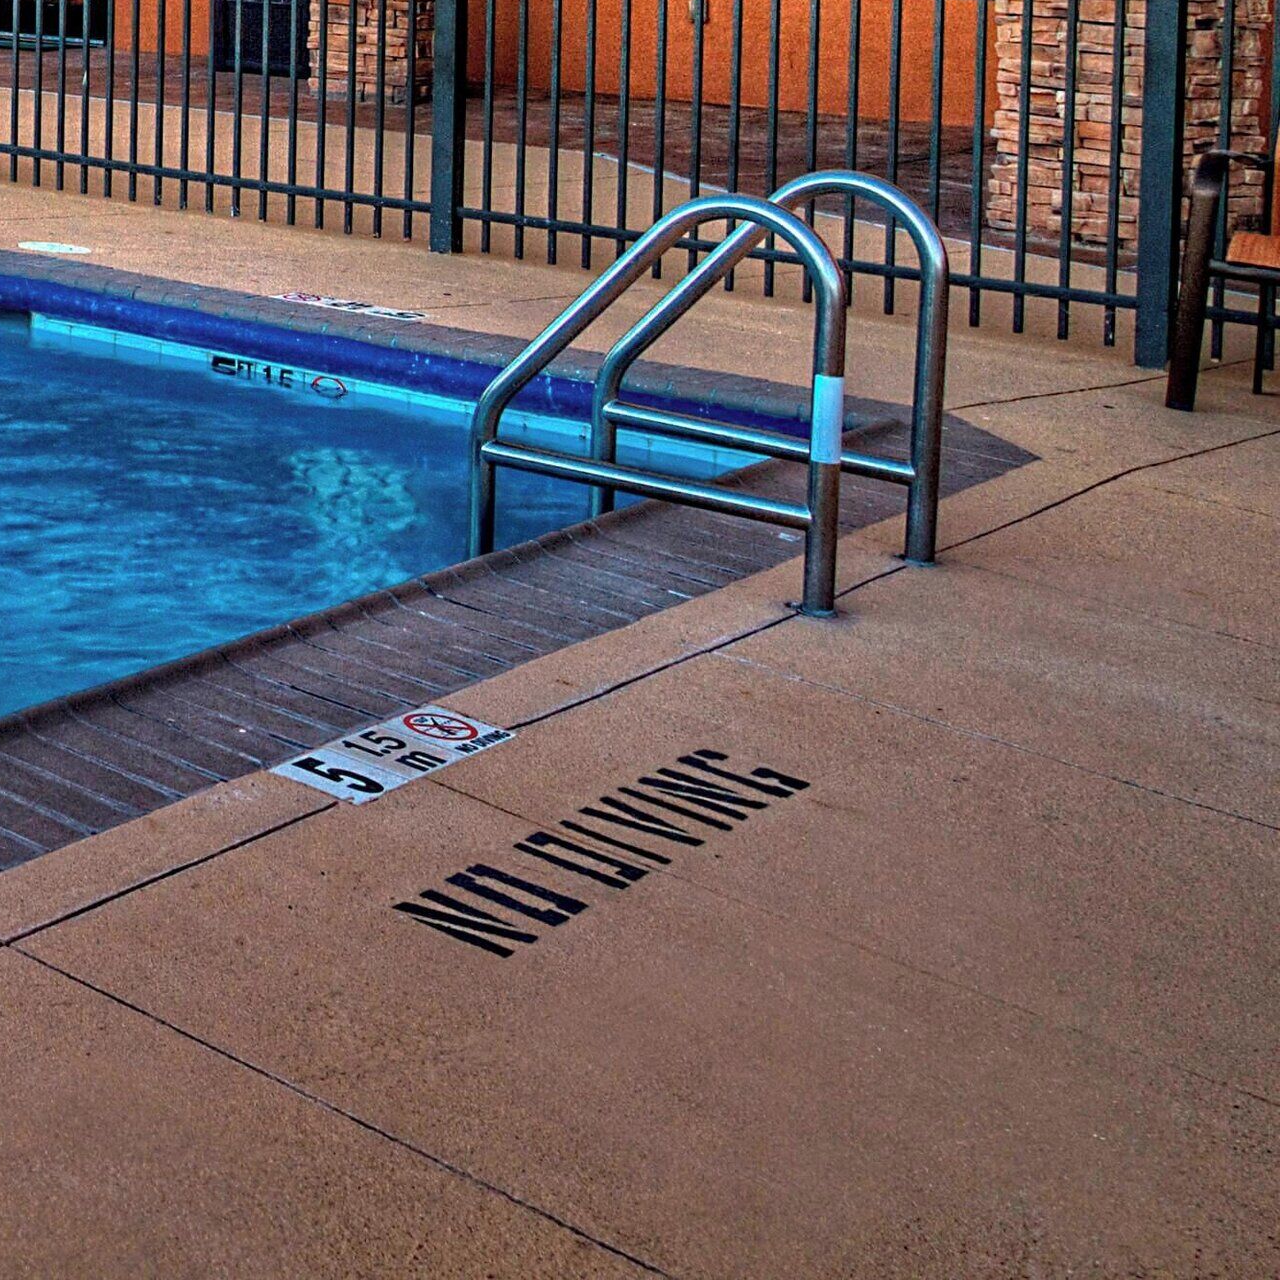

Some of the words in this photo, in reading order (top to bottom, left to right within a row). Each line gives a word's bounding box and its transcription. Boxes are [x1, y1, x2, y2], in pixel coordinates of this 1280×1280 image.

[341, 730, 407, 757] 1.5
[454, 739, 477, 754] NO
[477, 729, 512, 751] DIVING
[394, 750, 448, 772] m
[291, 757, 385, 794] 5
[392, 864, 589, 958] NO
[512, 748, 811, 890] DIVING
